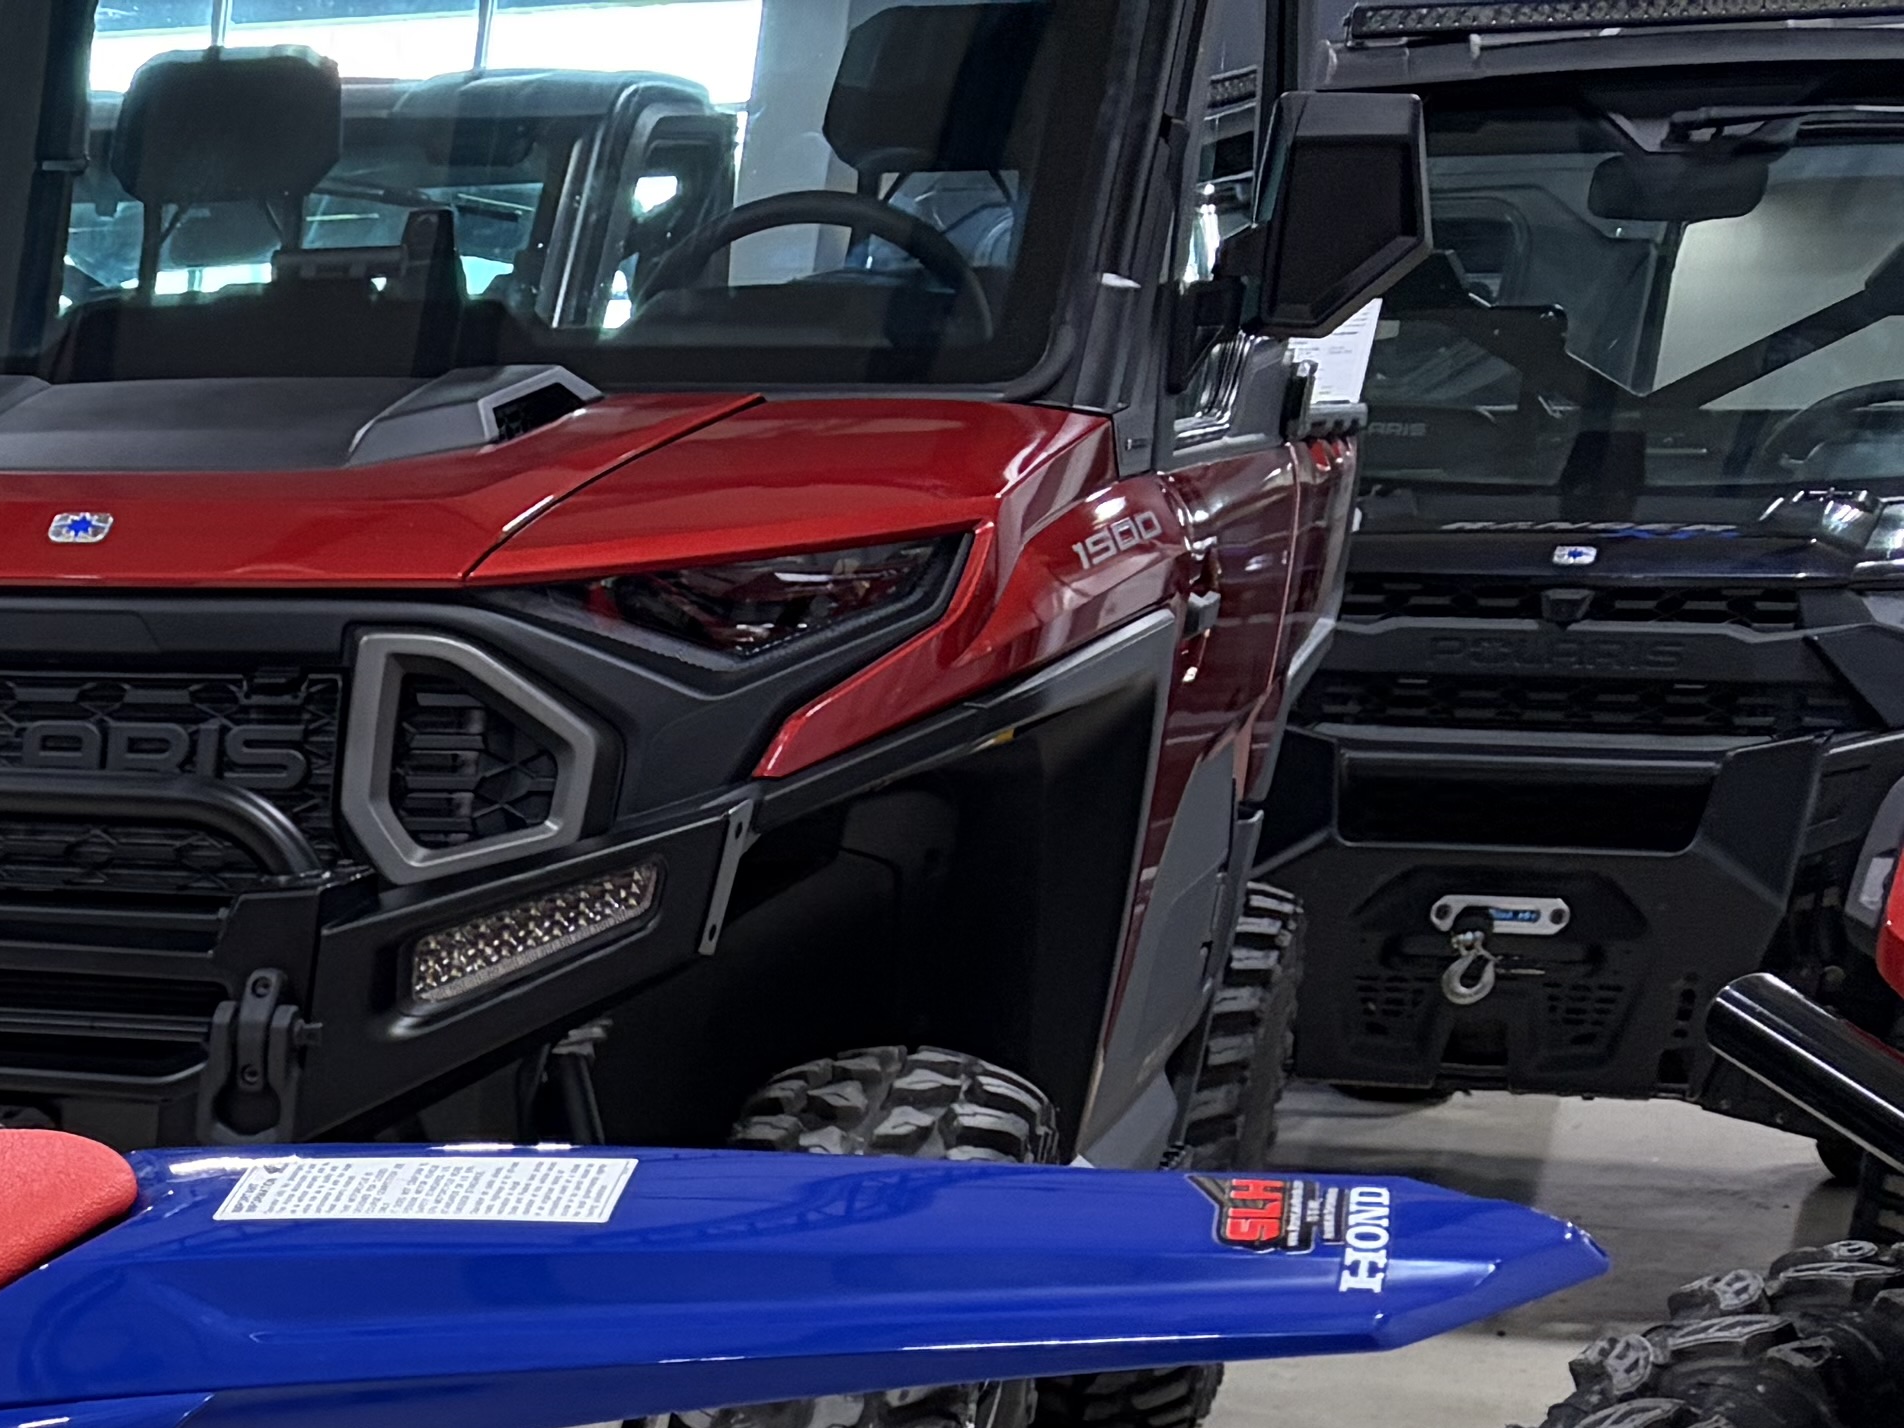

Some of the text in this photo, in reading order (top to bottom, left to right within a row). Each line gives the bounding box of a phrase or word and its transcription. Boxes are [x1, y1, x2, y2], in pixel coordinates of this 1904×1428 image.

[1367, 422, 1428, 437] ARIS
[1072, 511, 1162, 569] 1500
[1430, 636, 1687, 671] POLARIS
[1226, 1179, 1285, 1241] SLH
[1339, 1186, 1391, 1293] HOND
